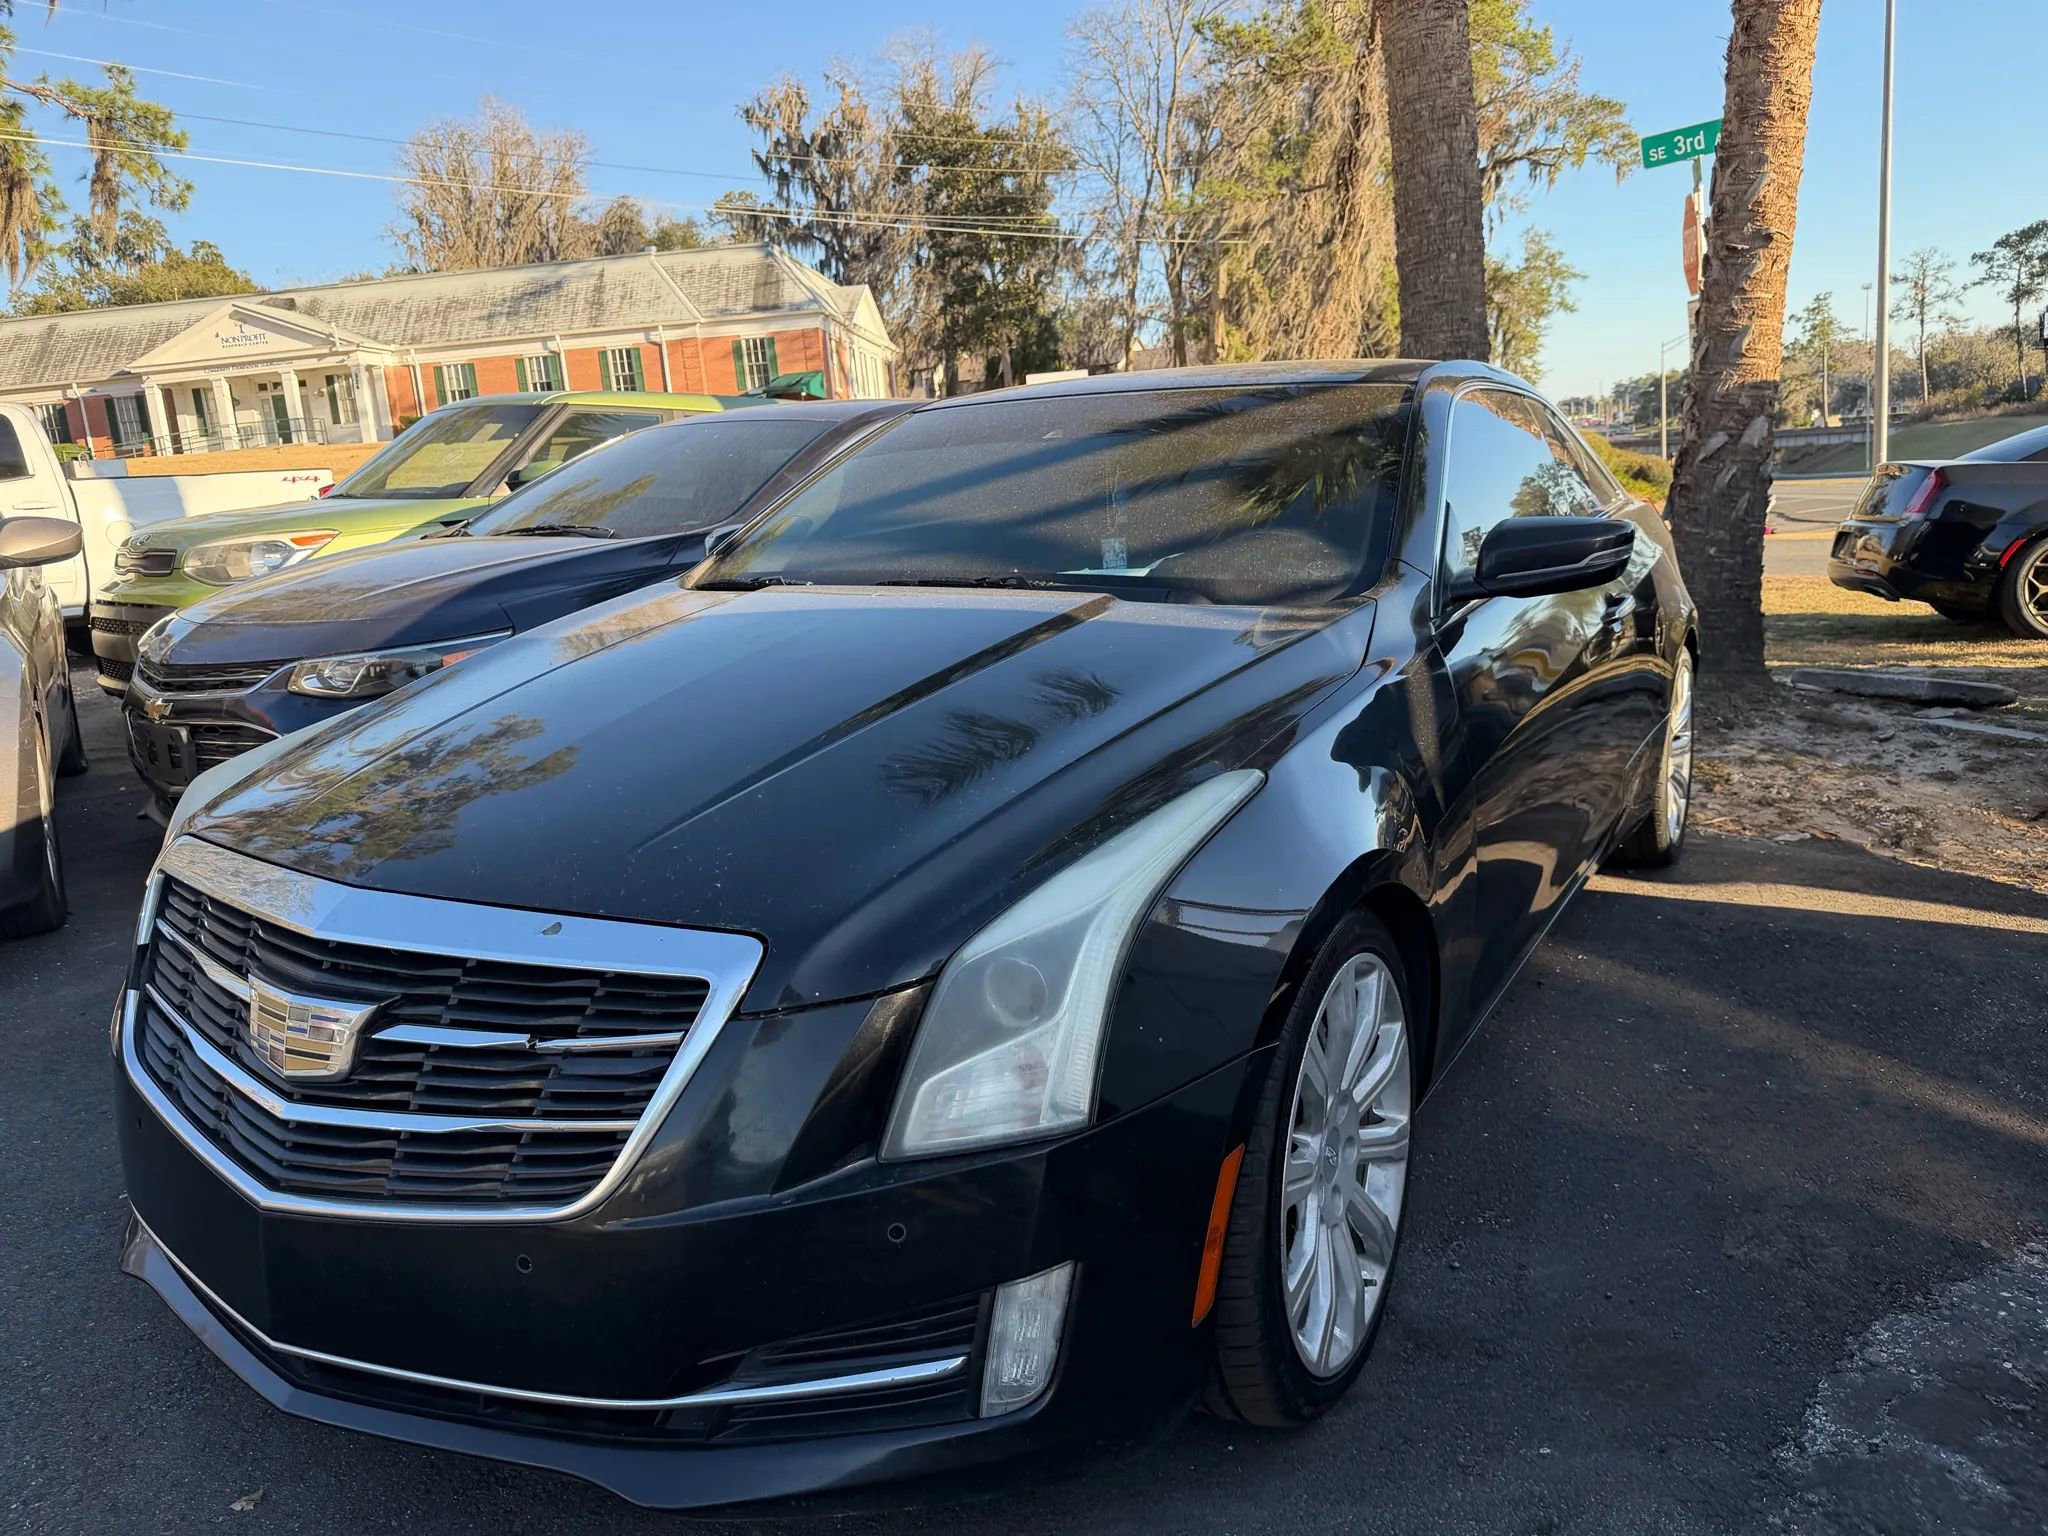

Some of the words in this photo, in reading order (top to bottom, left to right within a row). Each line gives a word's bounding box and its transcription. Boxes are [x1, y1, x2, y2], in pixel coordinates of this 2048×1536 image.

[1649, 146, 1667, 161] SE
[1673, 130, 1705, 155] 3rd
[221, 333, 266, 344] NONPROFIT
